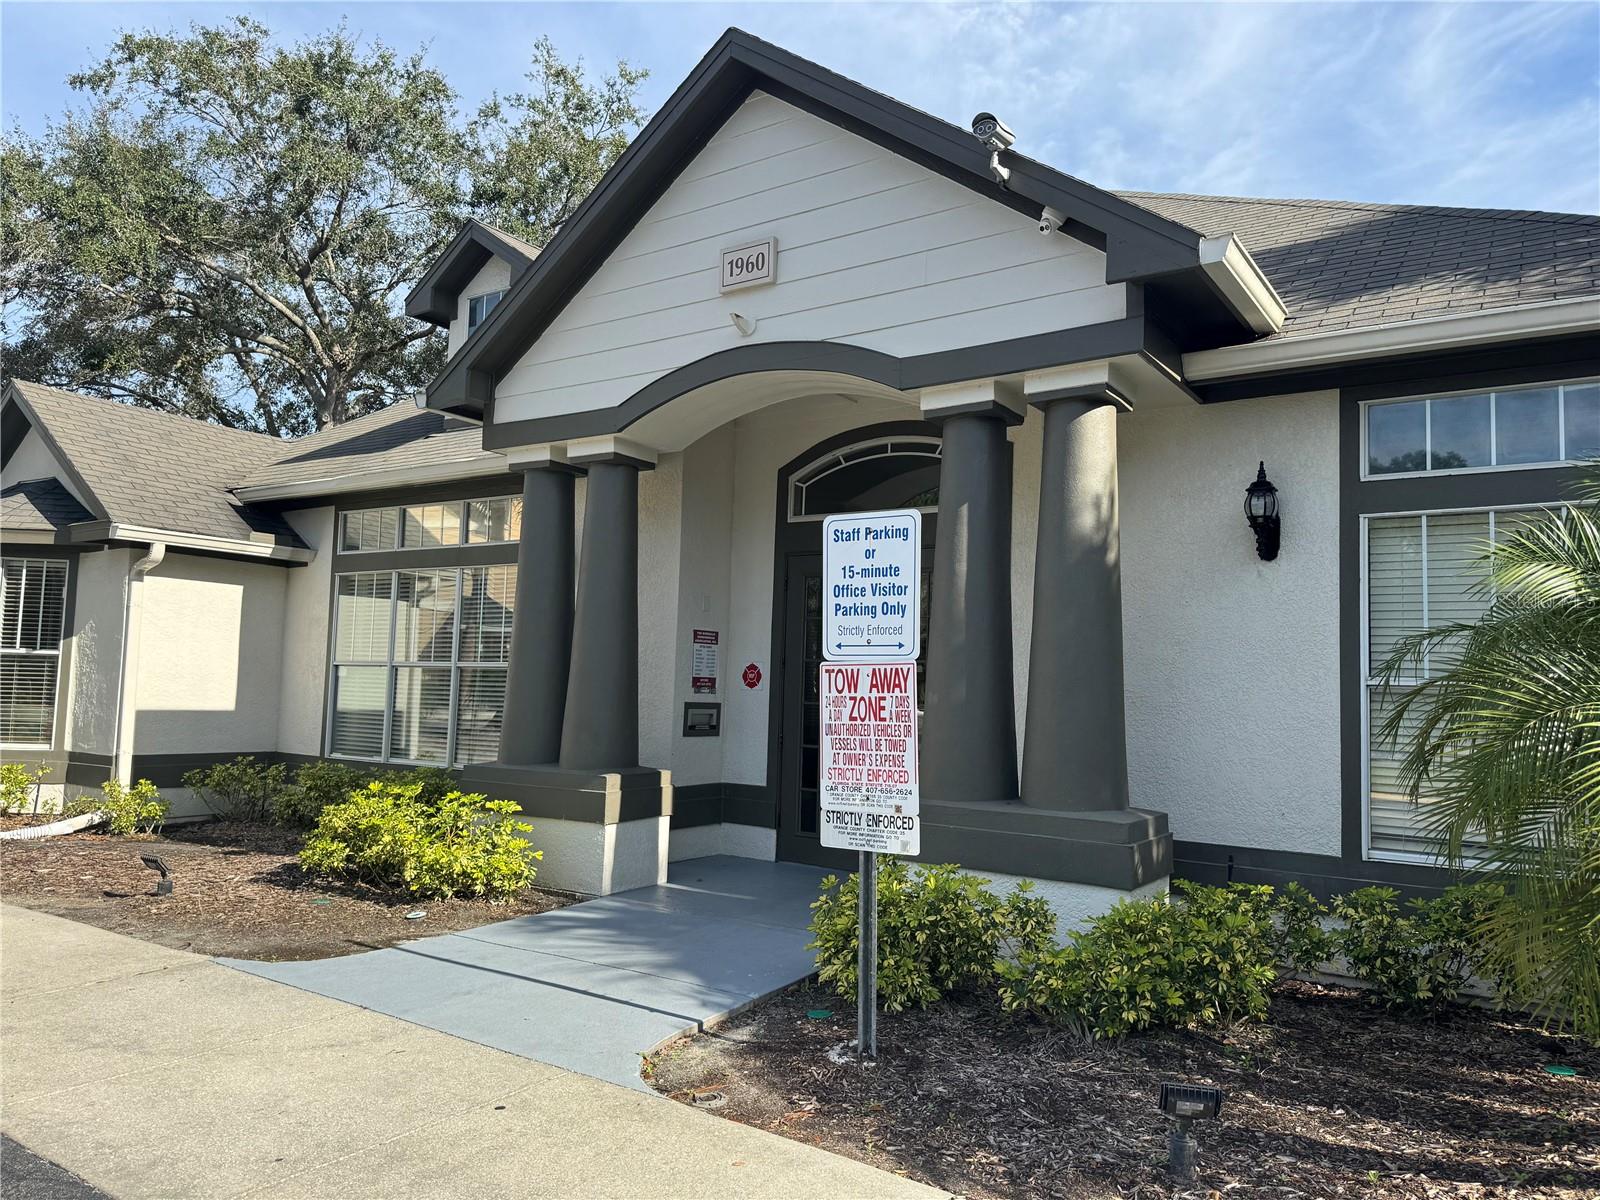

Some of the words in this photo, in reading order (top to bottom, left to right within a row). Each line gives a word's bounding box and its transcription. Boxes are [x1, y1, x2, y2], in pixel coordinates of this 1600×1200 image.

[728, 252, 765, 277] 1960
[833, 528, 860, 542] Staff
[865, 525, 909, 540] Parking
[865, 548, 876, 559] or
[842, 564, 900, 579] 15-minute
[833, 584, 866, 598] Office
[871, 582, 908, 597] Visitor
[835, 602, 877, 618] Parking
[882, 601, 907, 618] Only
[838, 624, 864, 638] Strictly
[867, 624, 903, 635] Enforced
[825, 668, 860, 694] TOW
[869, 667, 910, 693] AWAY
[825, 695, 831, 708] 24
[832, 695, 847, 708] HOURS
[848, 695, 887, 722] ZONE
[890, 695, 894, 708] 7
[895, 695, 910, 708] DAYS
[829, 709, 832, 722] A
[833, 709, 843, 722] DAY
[889, 710, 893, 723] A
[895, 710, 912, 723] WEEK
[825, 723, 871, 737] UNAUTHORIZED
[873, 724, 902, 737] VEHICLES
[903, 724, 912, 738] OR
[831, 738, 857, 751] VESSELS
[859, 738, 873, 751] WILL
[875, 738, 883, 752] BE
[884, 739, 907, 752] TOWED
[832, 752, 840, 765] AT
[843, 753, 873, 767] OWNER'S
[875, 754, 905, 768] EXPENSE
[828, 768, 863, 781] STRICTLY
[867, 769, 909, 783] ENFORCED
[865, 786, 913, 796] 407-656-2624
[826, 810, 863, 826] STRICTLY
[866, 813, 914, 831] ENFORCED
